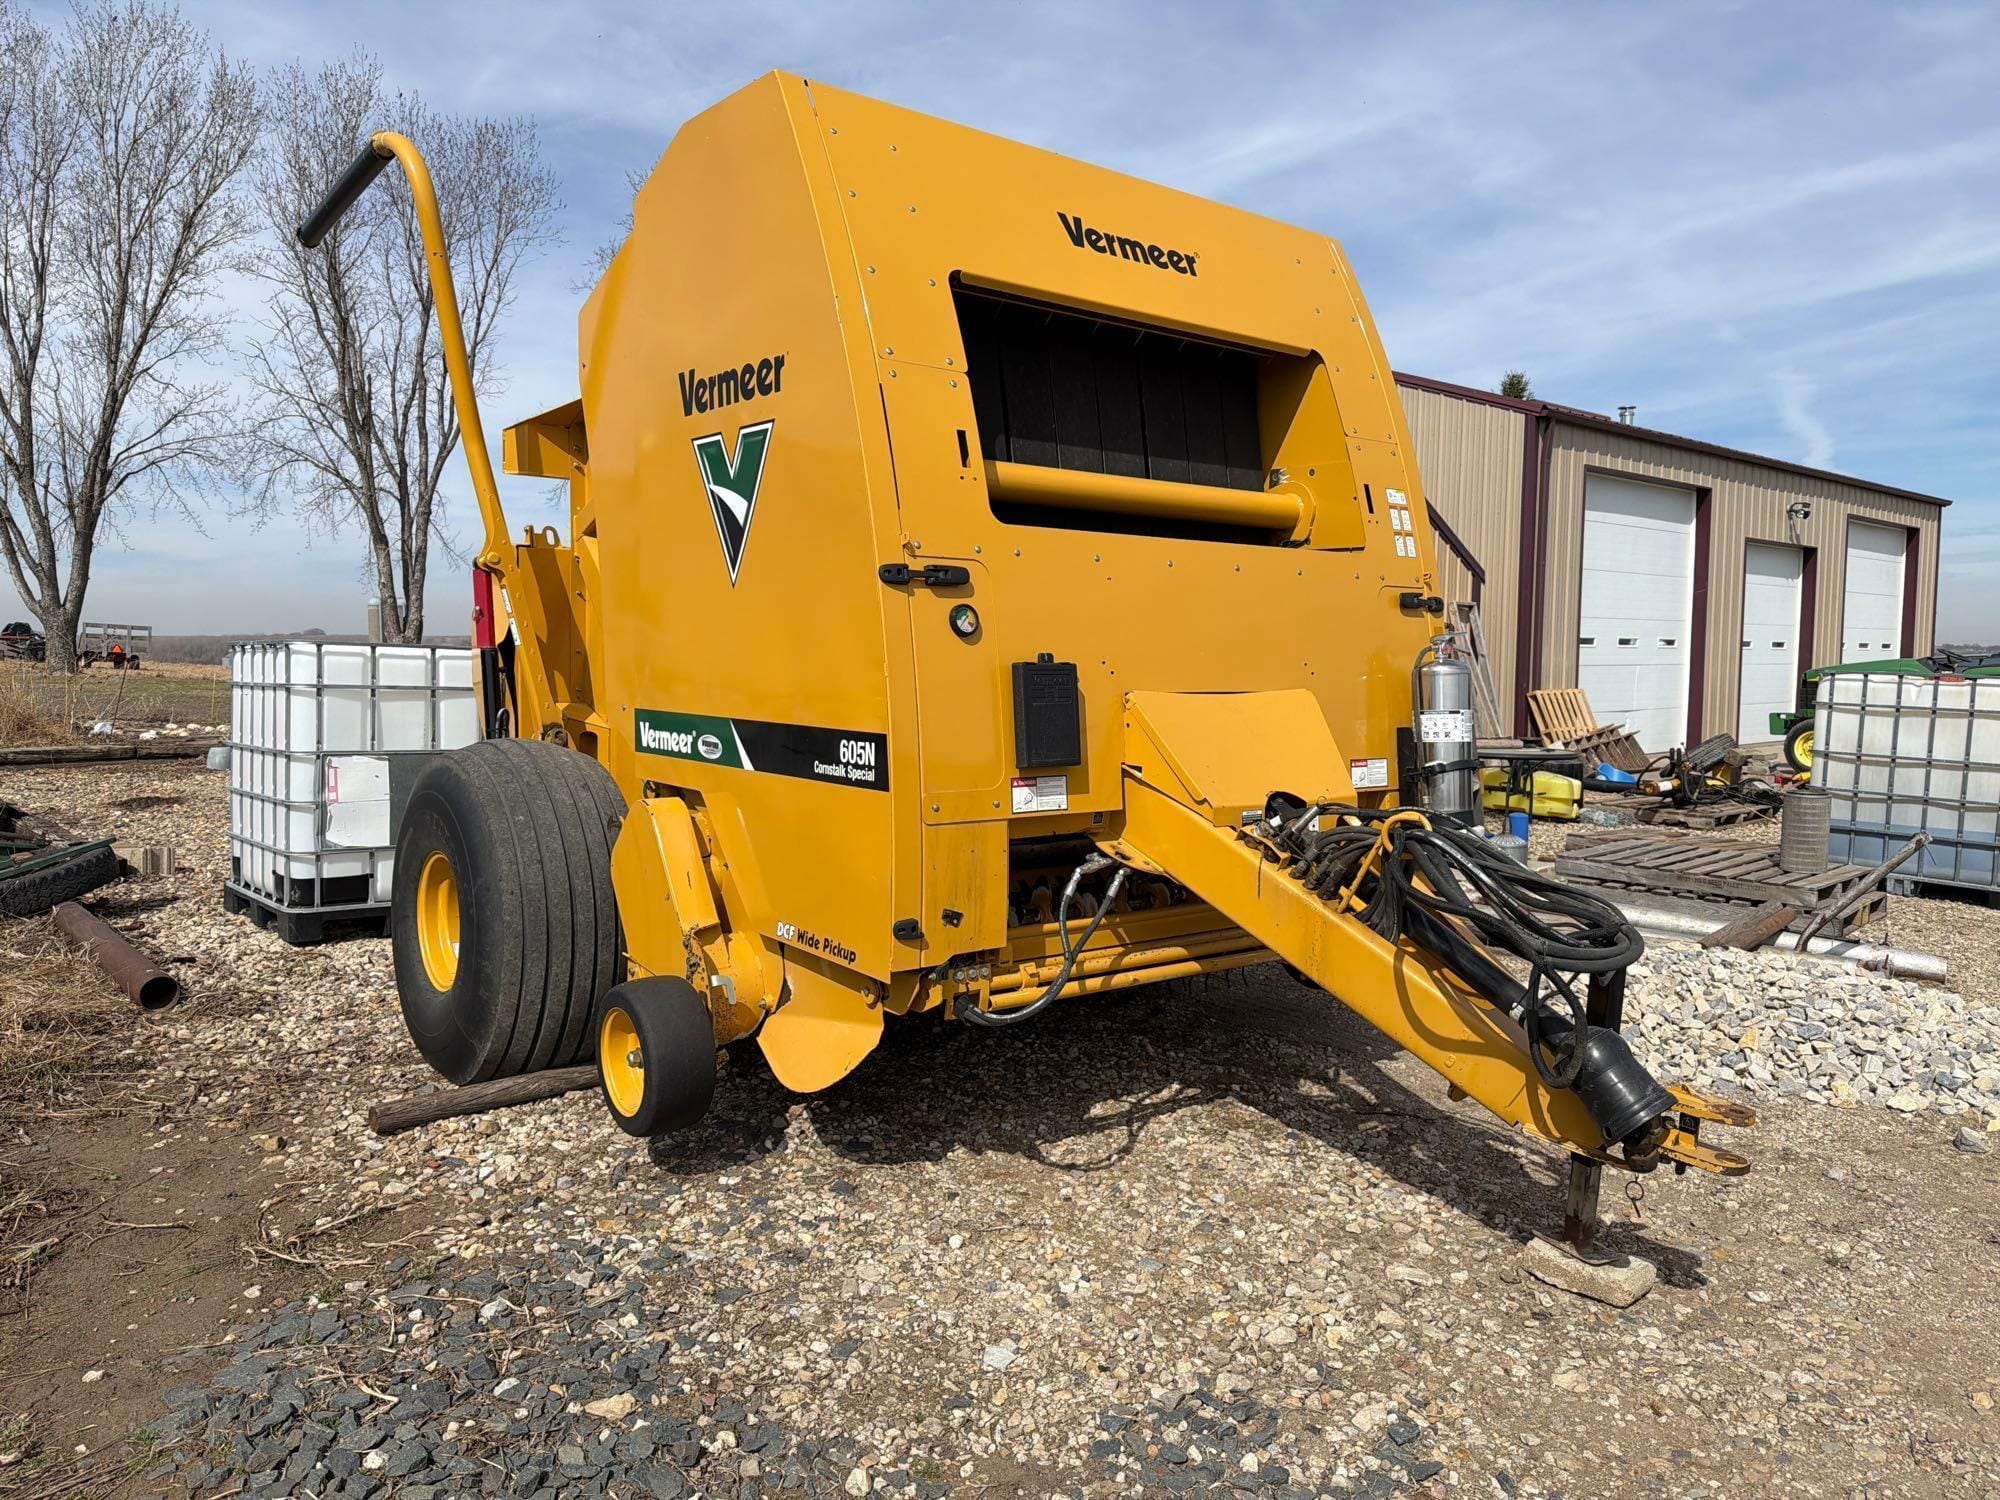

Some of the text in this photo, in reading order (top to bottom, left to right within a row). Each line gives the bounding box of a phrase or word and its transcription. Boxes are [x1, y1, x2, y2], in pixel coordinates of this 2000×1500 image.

[1056, 211, 1198, 277] Vermeer
[678, 353, 786, 417] Vermeer
[639, 721, 694, 754] Vermeer
[840, 739, 876, 767] 605N
[813, 760, 875, 782] Cornstalk Special
[777, 920, 857, 965] DCF Wide Pickup
